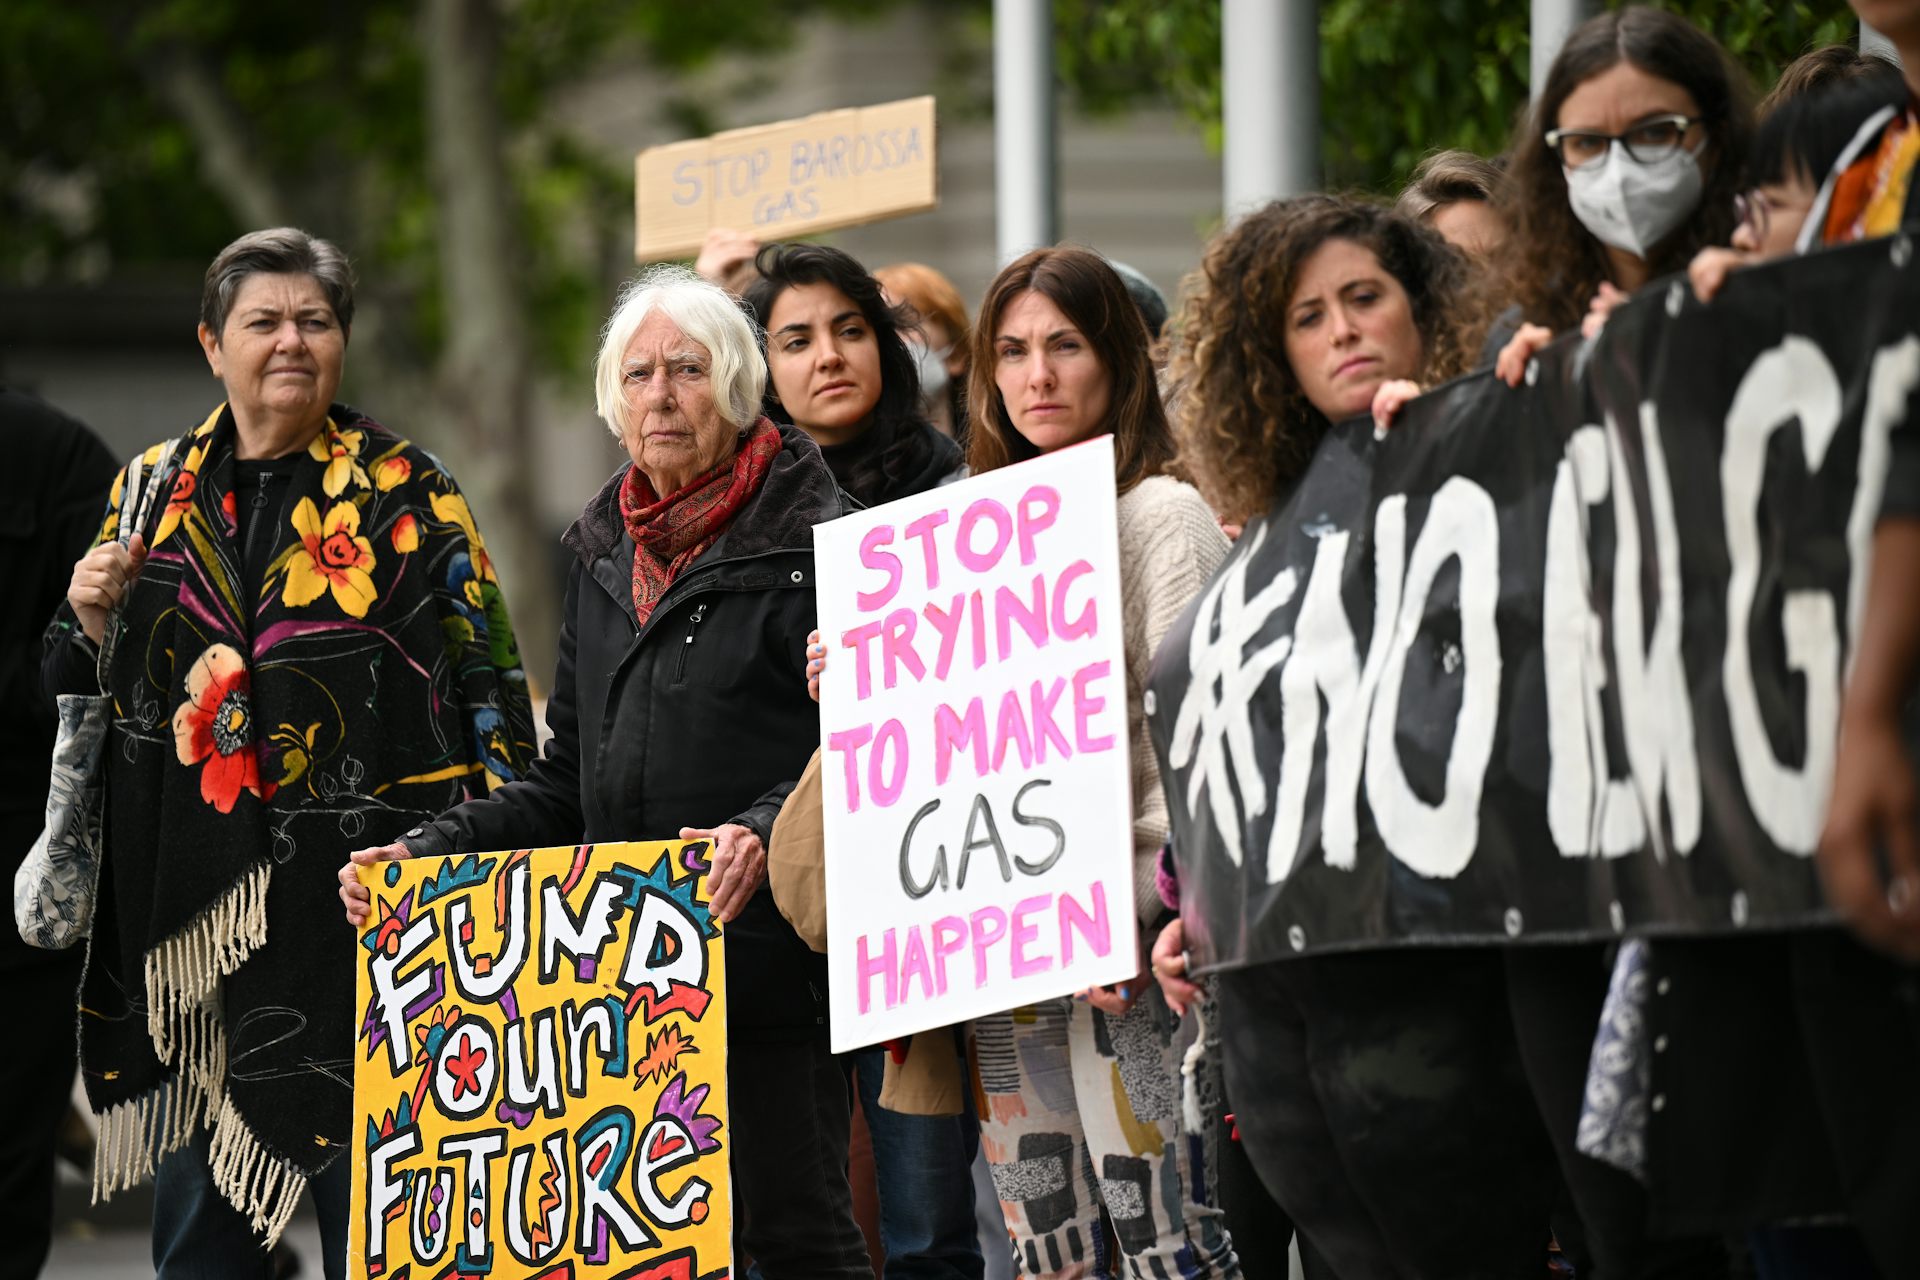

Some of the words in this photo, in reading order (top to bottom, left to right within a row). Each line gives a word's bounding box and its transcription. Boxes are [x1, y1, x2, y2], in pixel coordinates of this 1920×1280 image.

[672, 147, 772, 207] STOP
[789, 124, 924, 186] BAROSSA
[752, 186, 821, 226] GAS
[857, 484, 1061, 612] STOP
[841, 559, 1098, 700] TRYING
[828, 718, 909, 814] TO
[935, 659, 1116, 786] MAKE
[899, 779, 1067, 900] GAS
[368, 862, 709, 1078] FUND
[857, 880, 1112, 1015] HAPPEN
